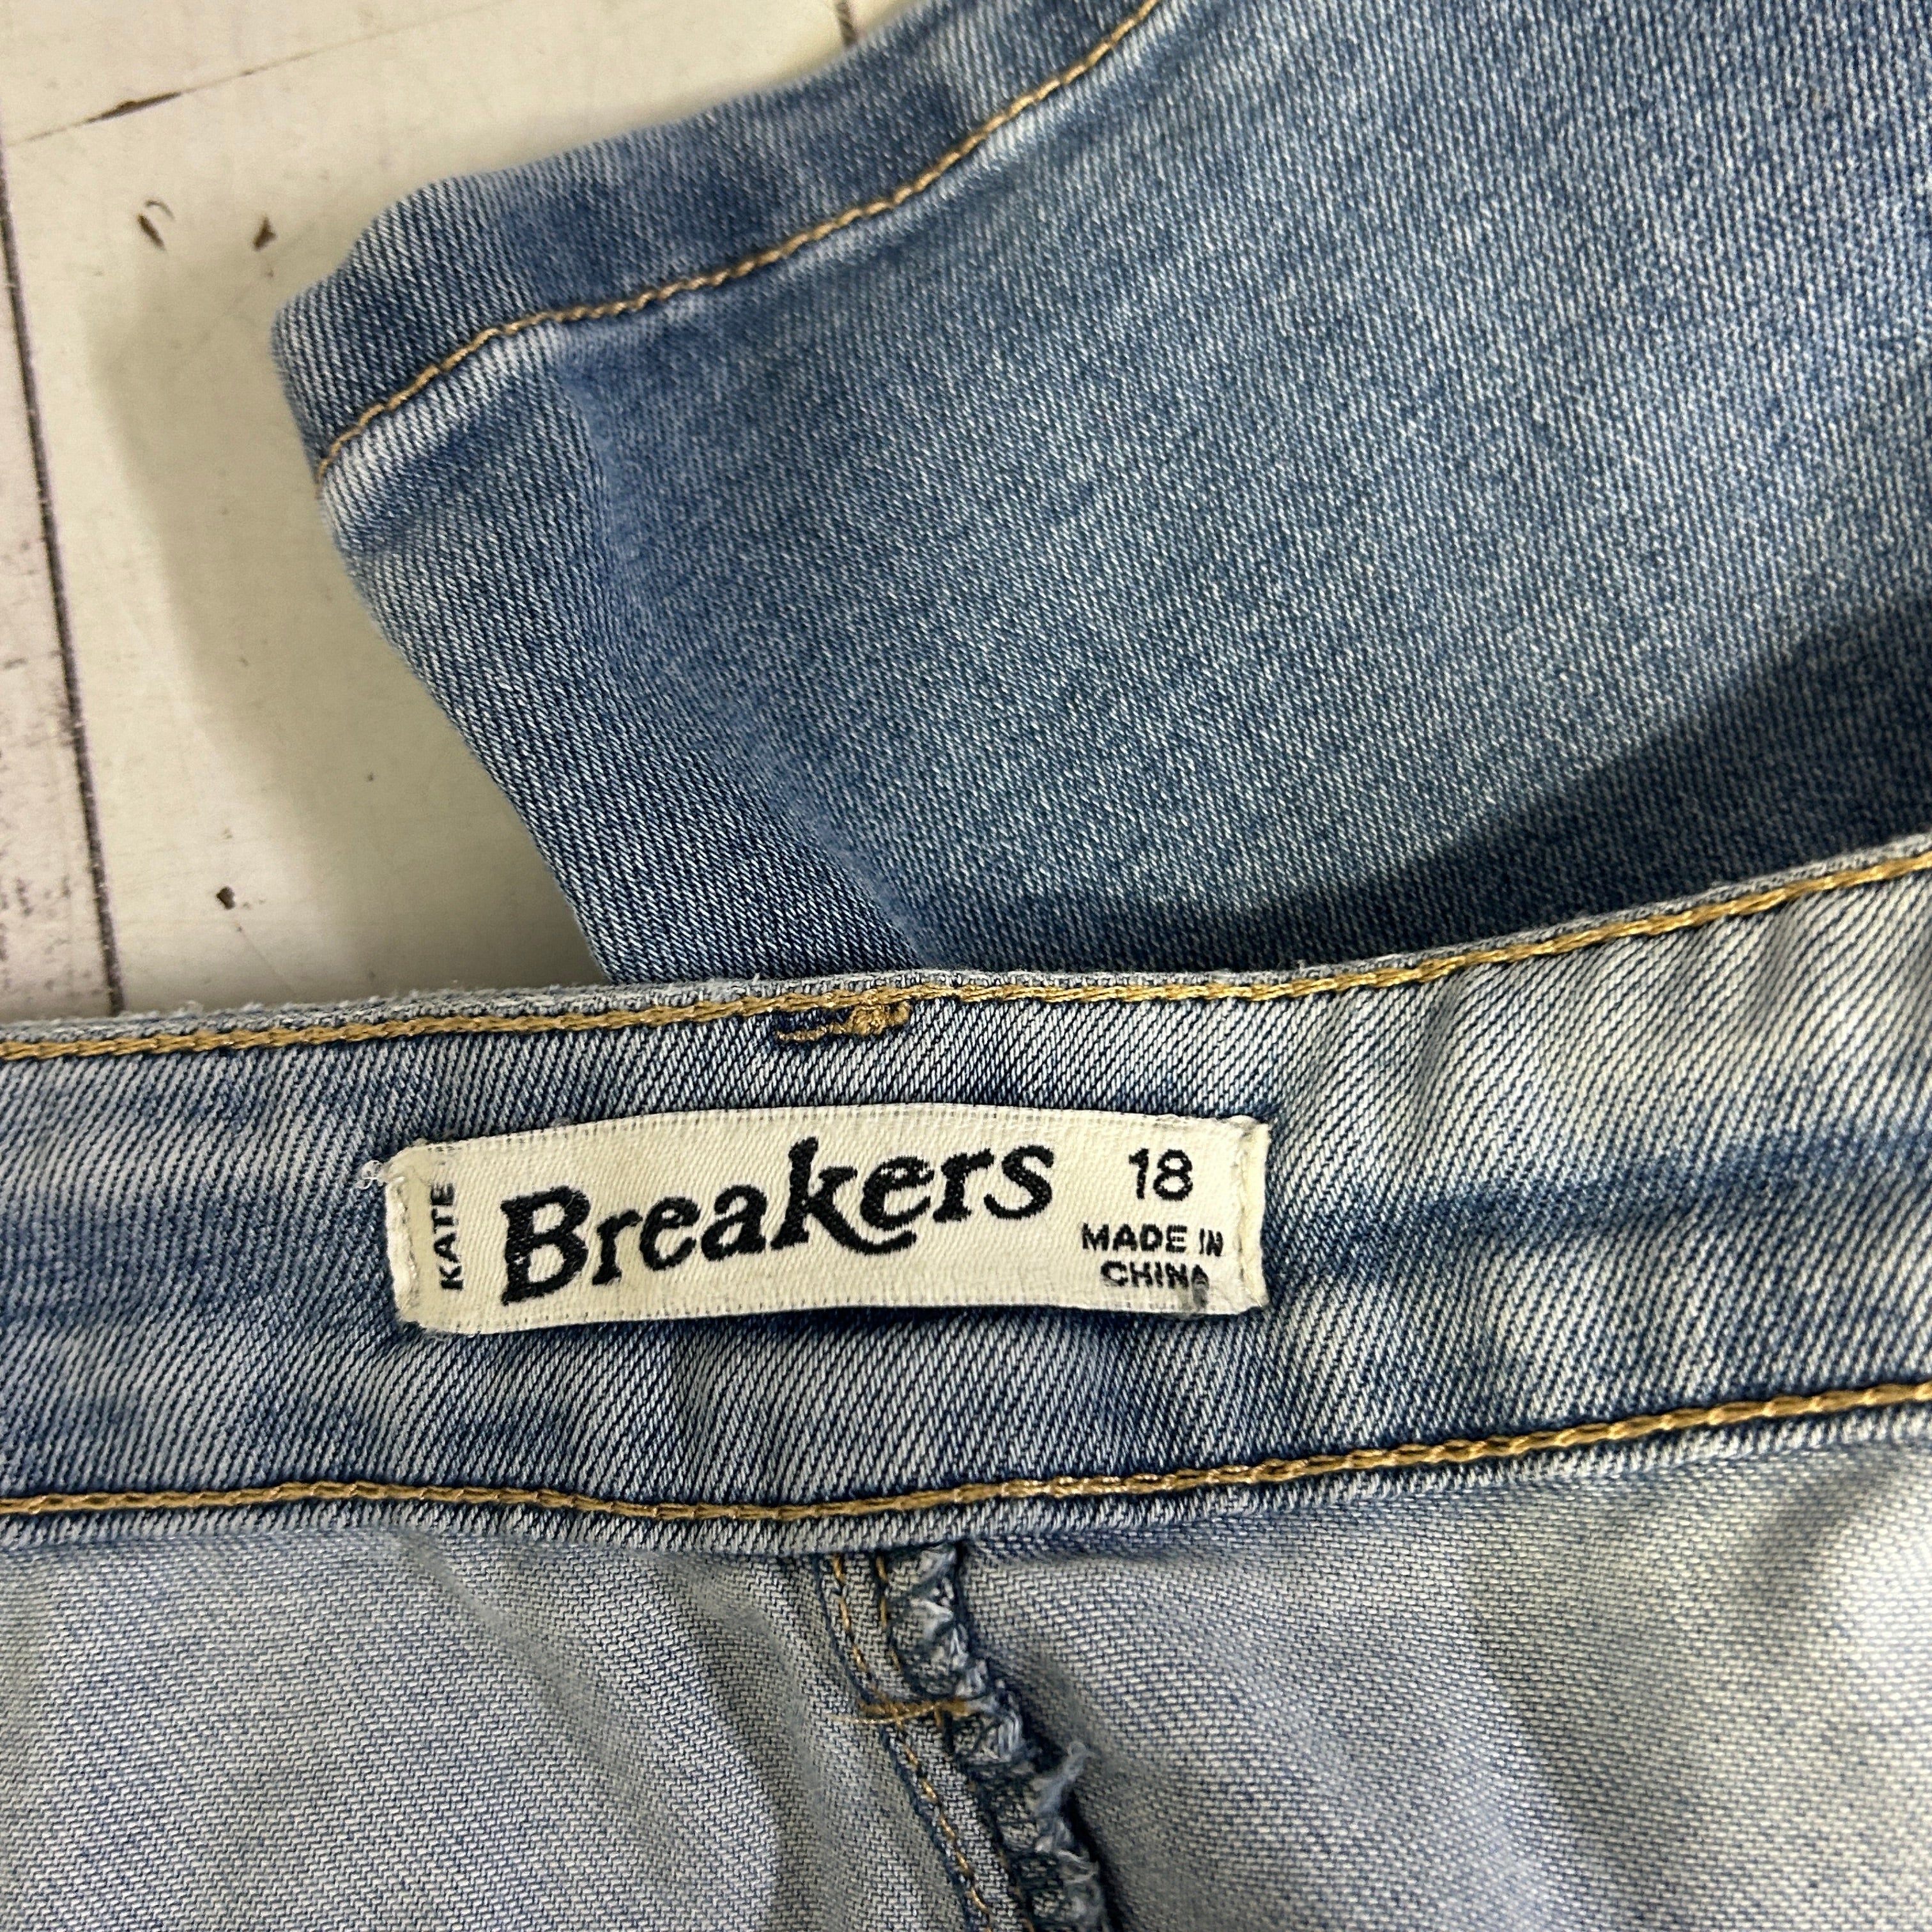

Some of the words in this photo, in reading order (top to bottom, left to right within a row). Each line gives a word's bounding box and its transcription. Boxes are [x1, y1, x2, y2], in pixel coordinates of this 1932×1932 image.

[1128, 1148, 1193, 1202] 18
[430, 1184, 463, 1291] KATE
[500, 1137, 1054, 1307] Breakers
[1082, 1223, 1187, 1254] MADE
[1199, 1229, 1223, 1257] IN
[1100, 1261, 1209, 1290] CHINA
